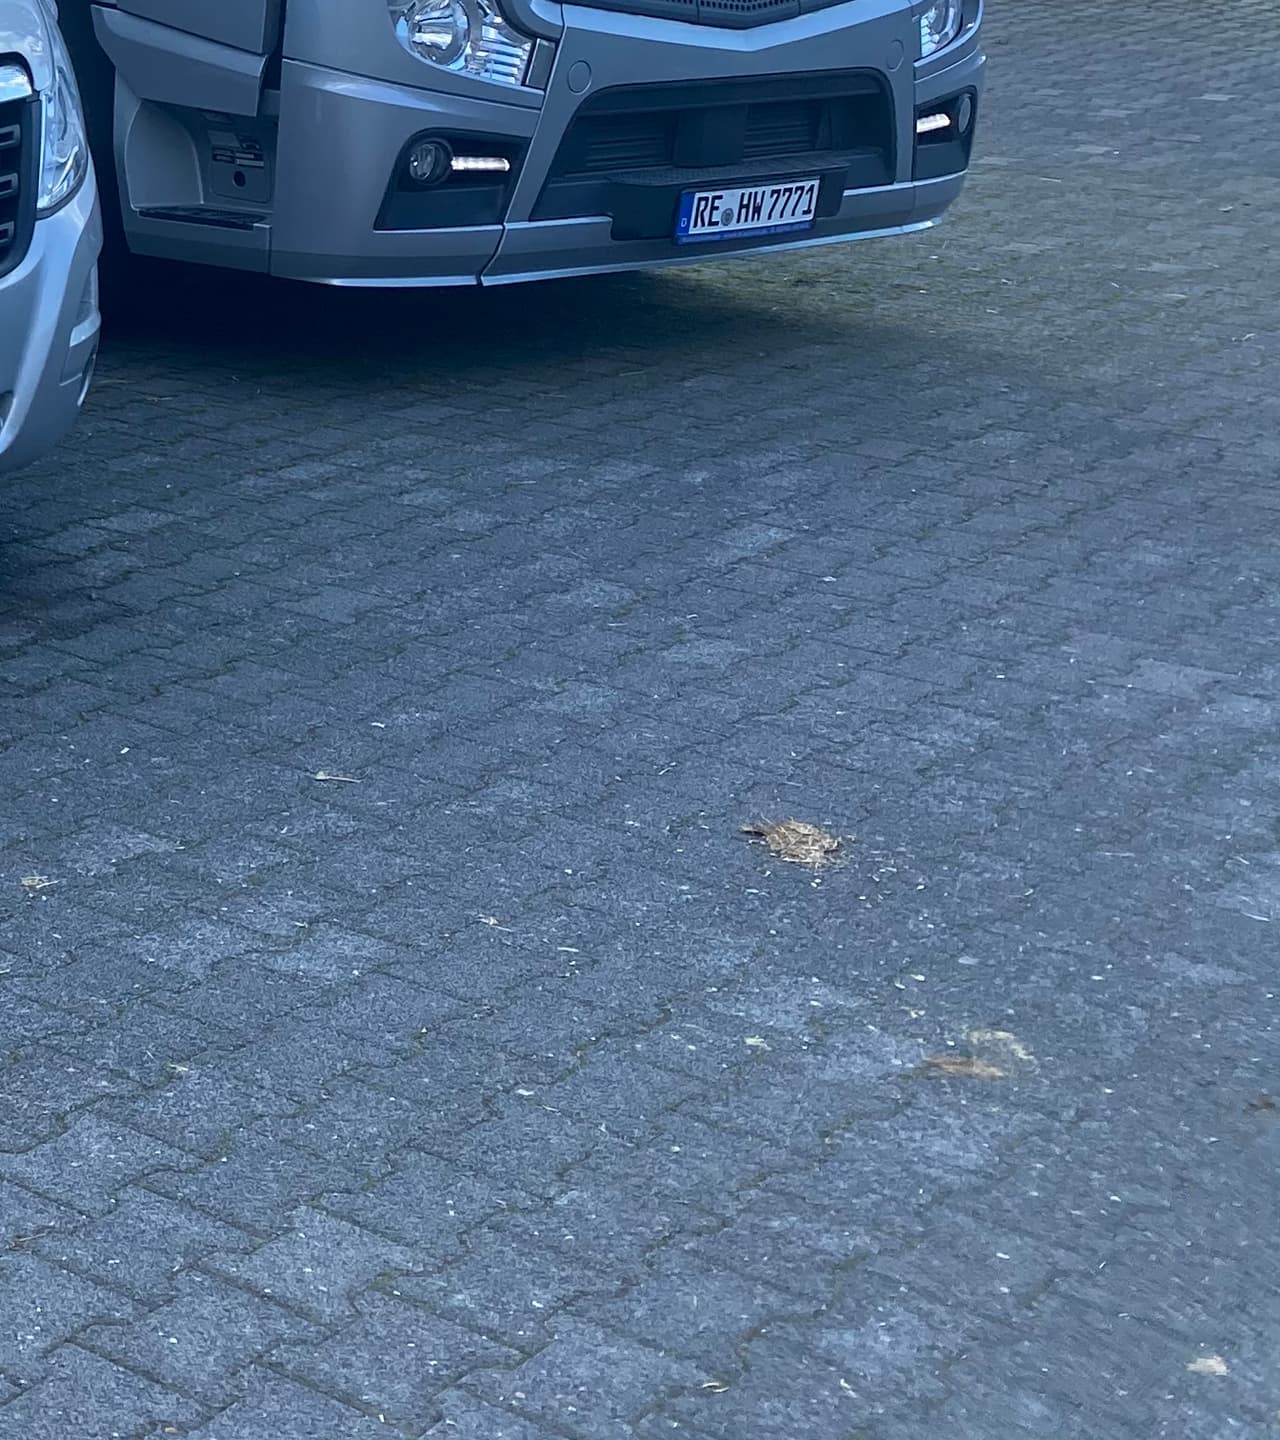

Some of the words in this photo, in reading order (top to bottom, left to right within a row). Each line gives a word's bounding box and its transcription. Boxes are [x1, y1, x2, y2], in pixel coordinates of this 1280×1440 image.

[692, 195, 723, 228] RE
[736, 190, 766, 224] HW
[768, 184, 816, 220] 7771
